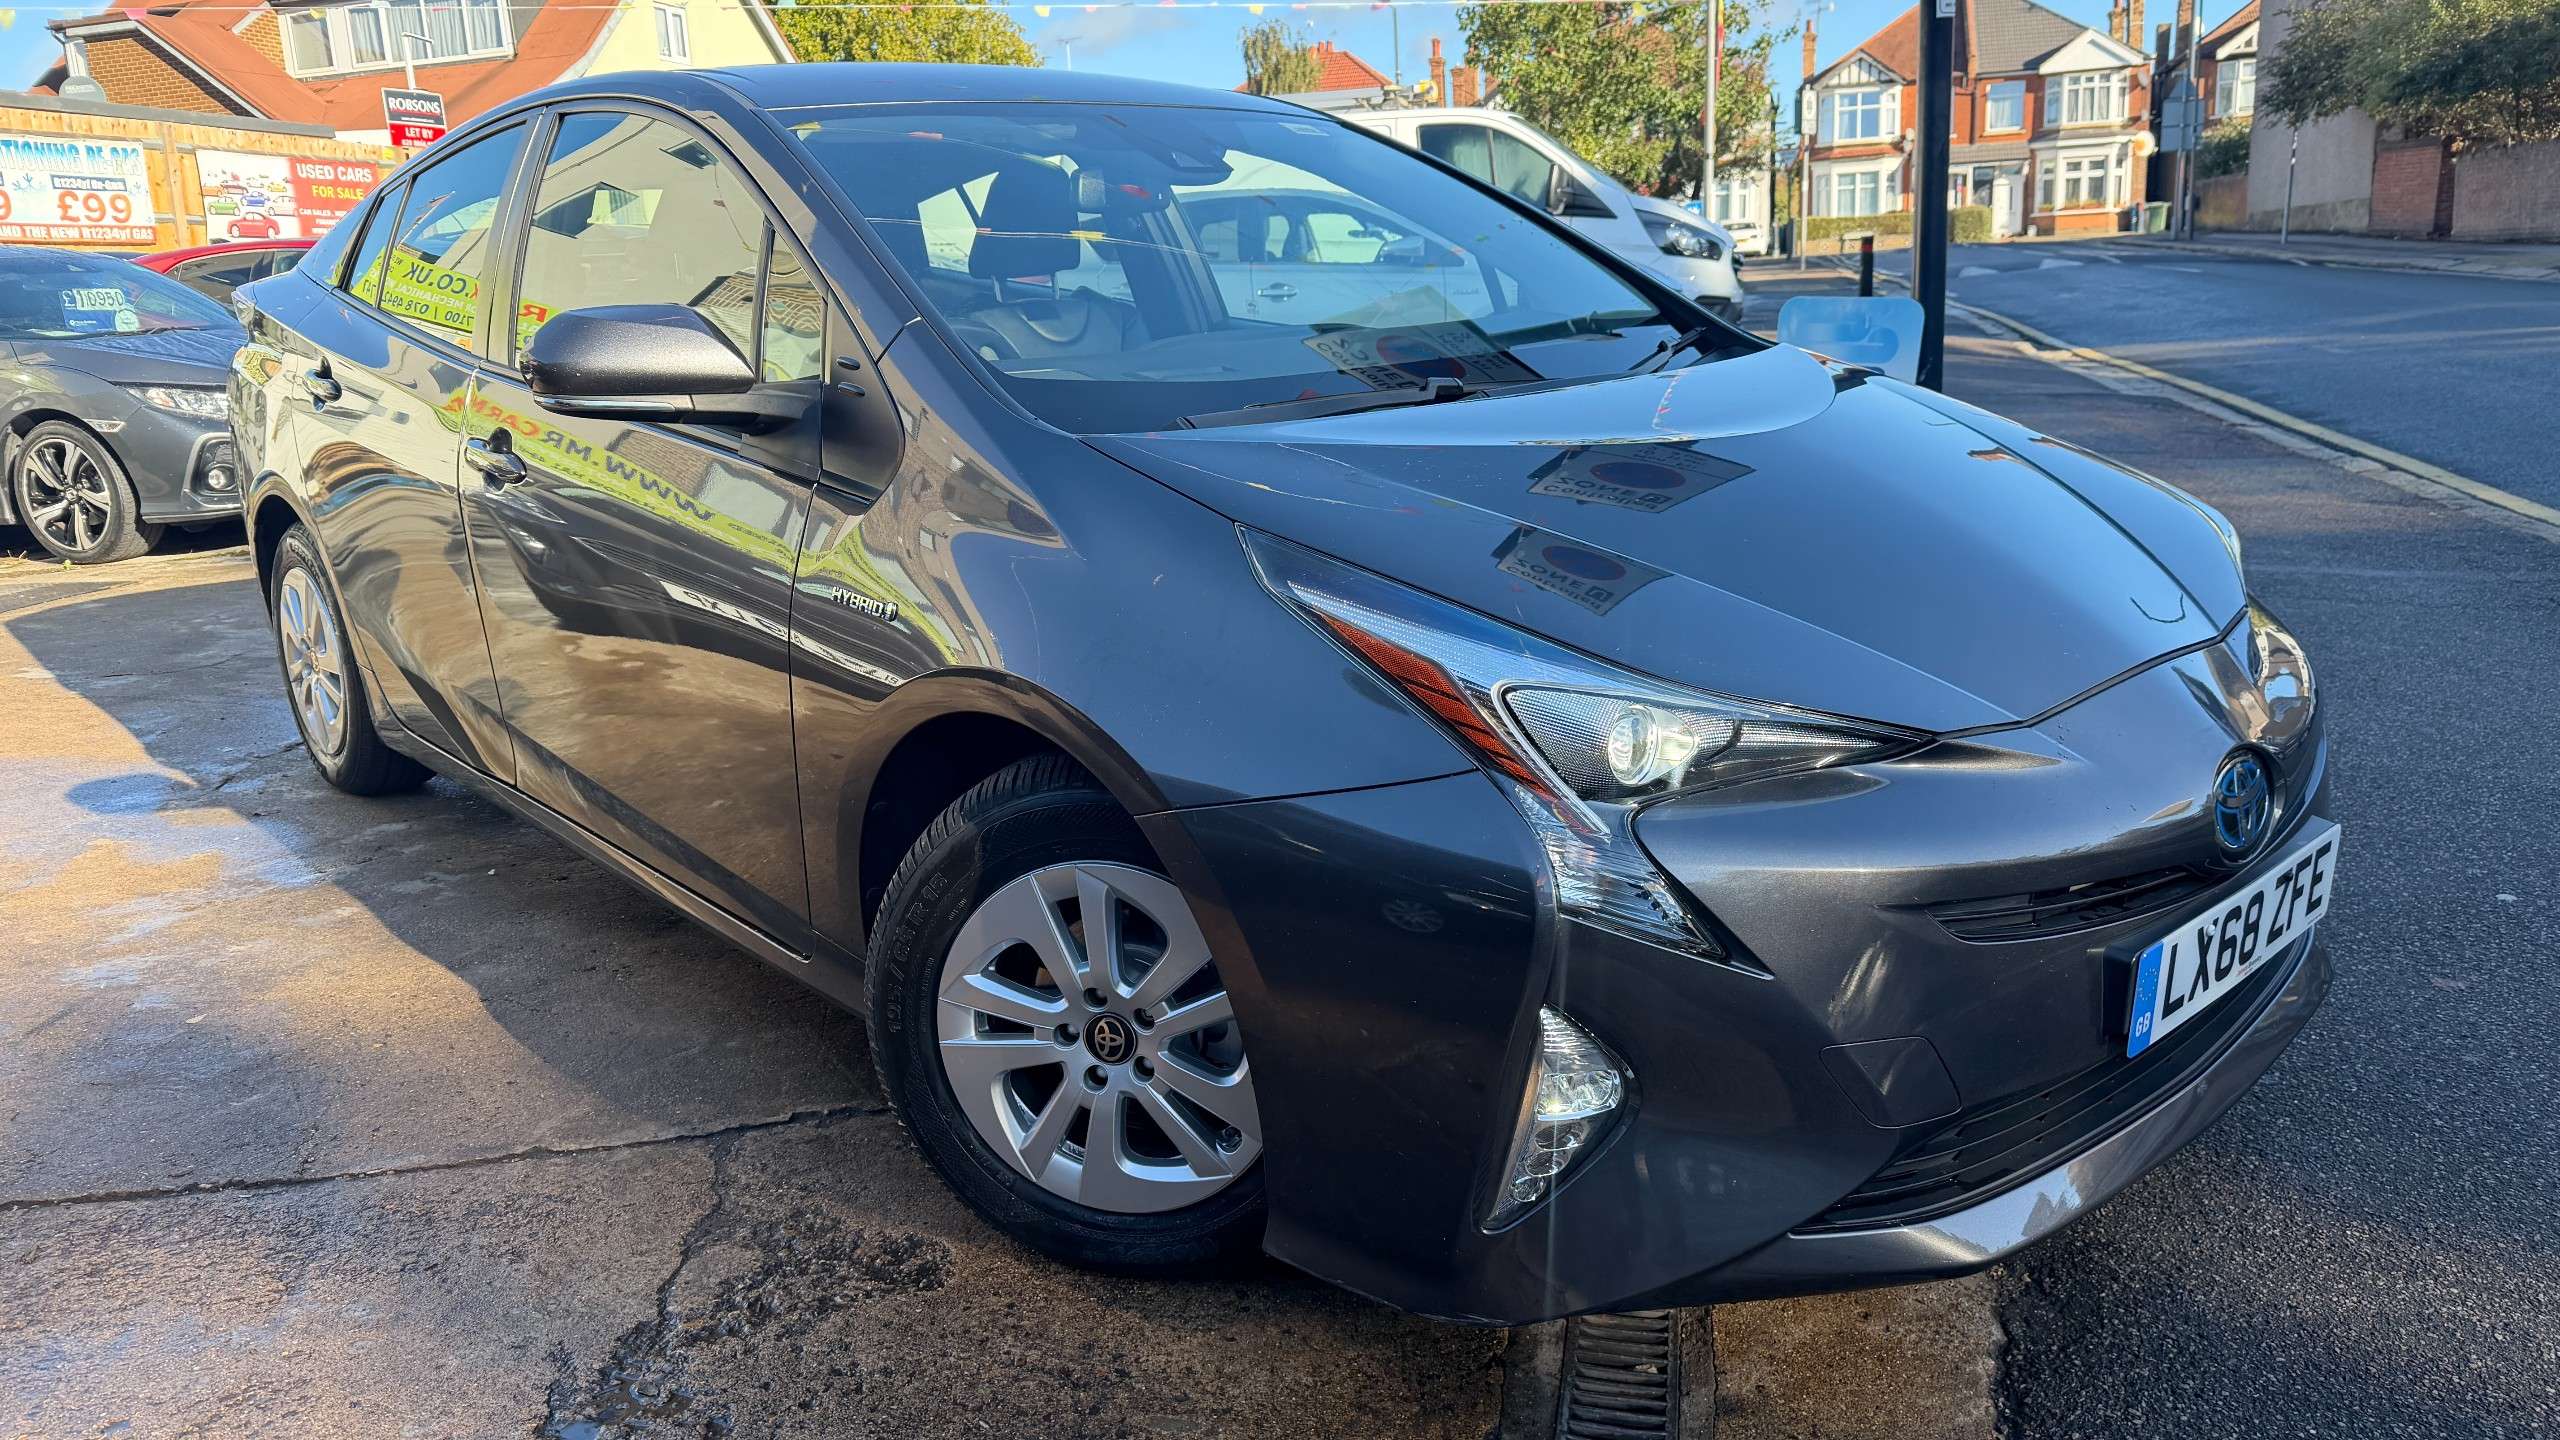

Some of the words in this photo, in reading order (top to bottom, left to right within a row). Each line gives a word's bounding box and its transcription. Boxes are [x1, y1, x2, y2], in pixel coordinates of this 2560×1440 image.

[388, 97, 441, 113] ROBSONS
[405, 127, 420, 138] LET
[421, 128, 434, 139] BY
[296, 163, 334, 180] USED
[337, 166, 373, 183] CARS
[312, 185, 334, 198] FOR
[337, 187, 365, 200] SALE
[58, 191, 132, 224] £99
[24, 226, 48, 238] THE
[49, 227, 80, 239] NEW
[132, 228, 154, 240] GAS
[831, 586, 884, 616] HYBRID
[2162, 890, 2265, 1021] LX68
[2266, 840, 2333, 948] ZFE
[2135, 1011, 2151, 1038] GB
